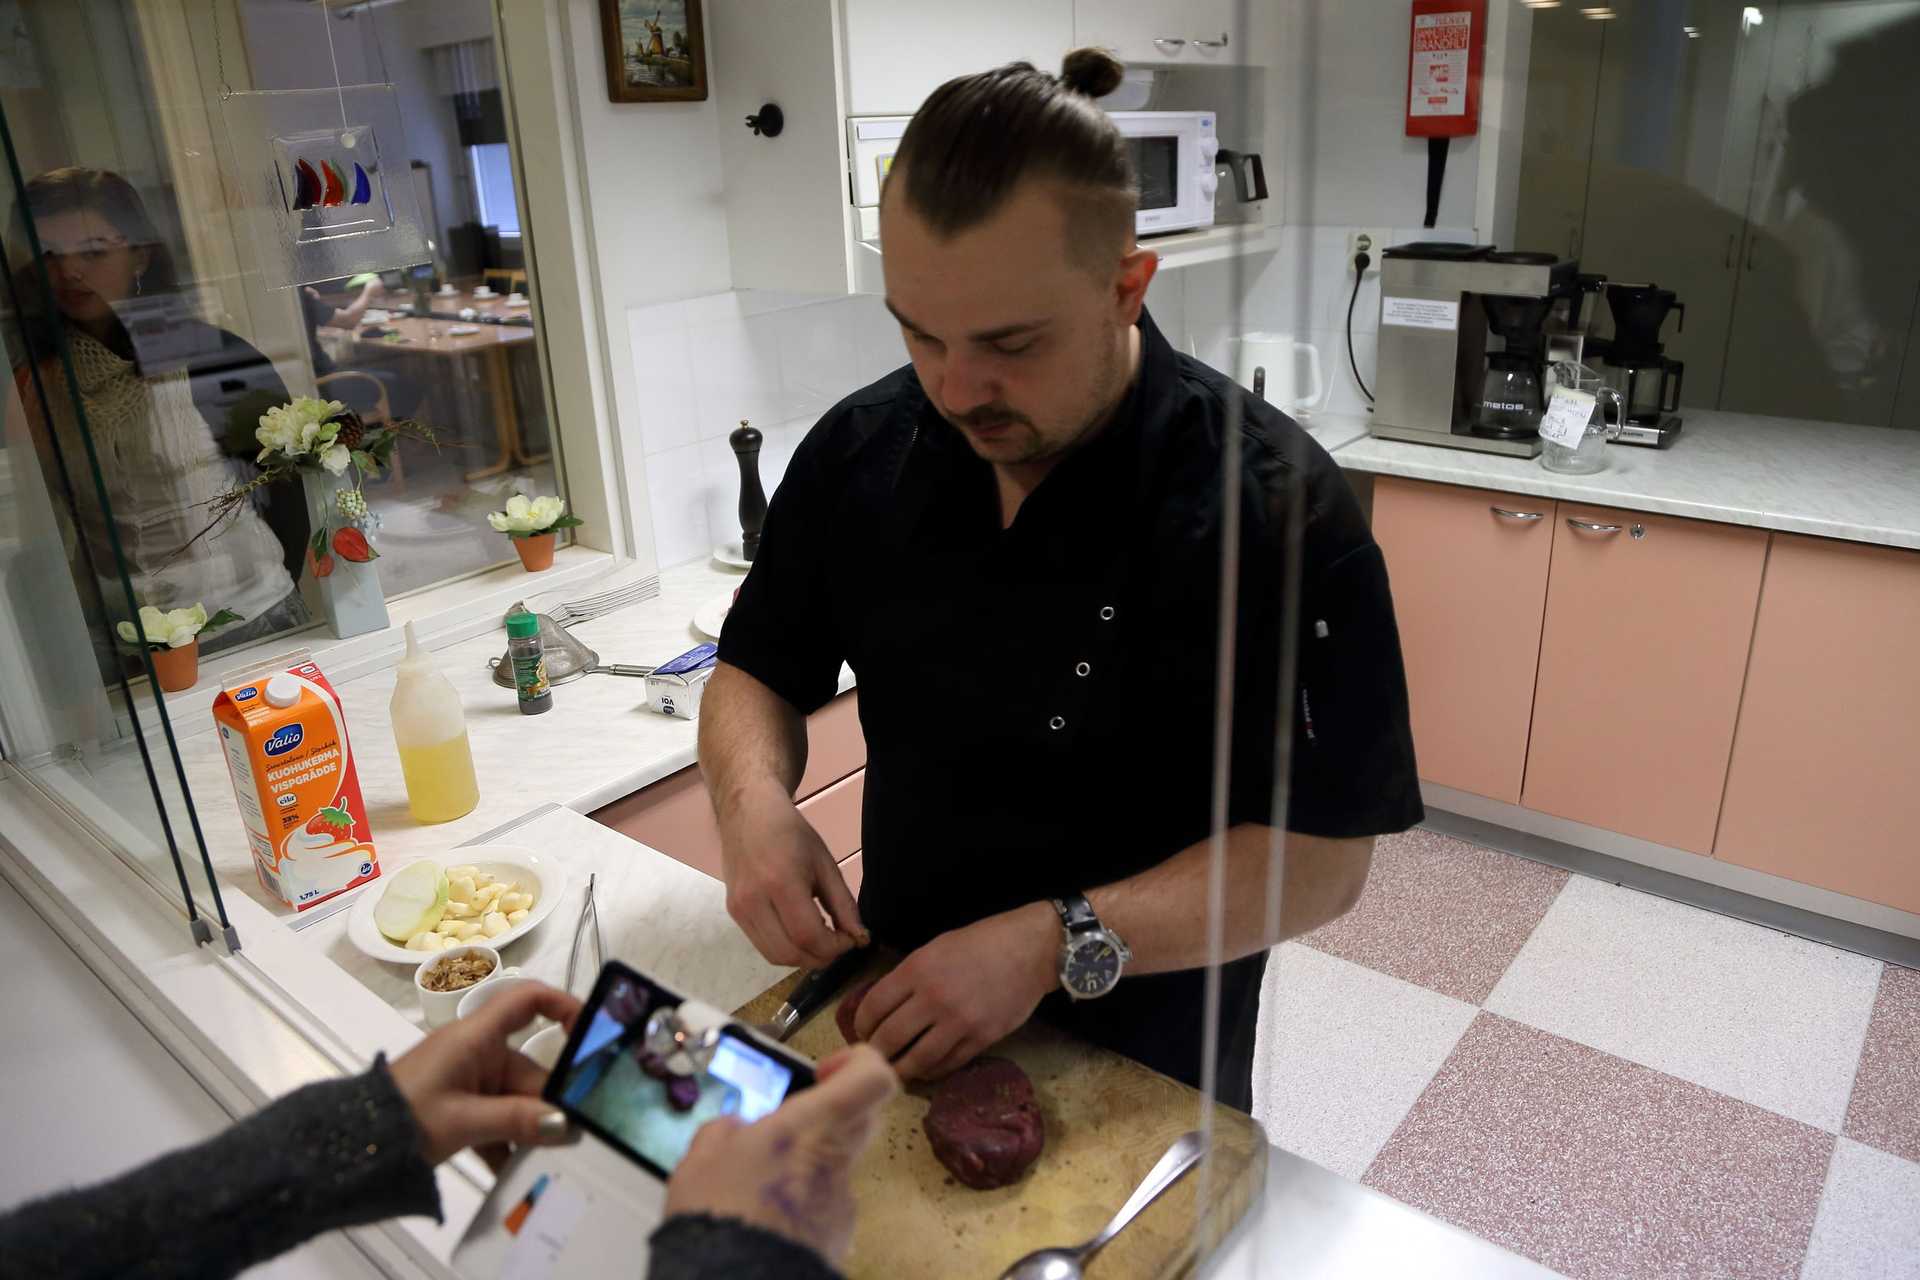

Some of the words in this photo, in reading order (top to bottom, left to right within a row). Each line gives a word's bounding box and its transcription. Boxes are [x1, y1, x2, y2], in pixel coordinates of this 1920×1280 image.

[1482, 400, 1524, 410] metos
[268, 733, 301, 751] Valio
[267, 748, 340, 783] KUOHUKERMA
[270, 762, 337, 793] VISPGRÄDDE
